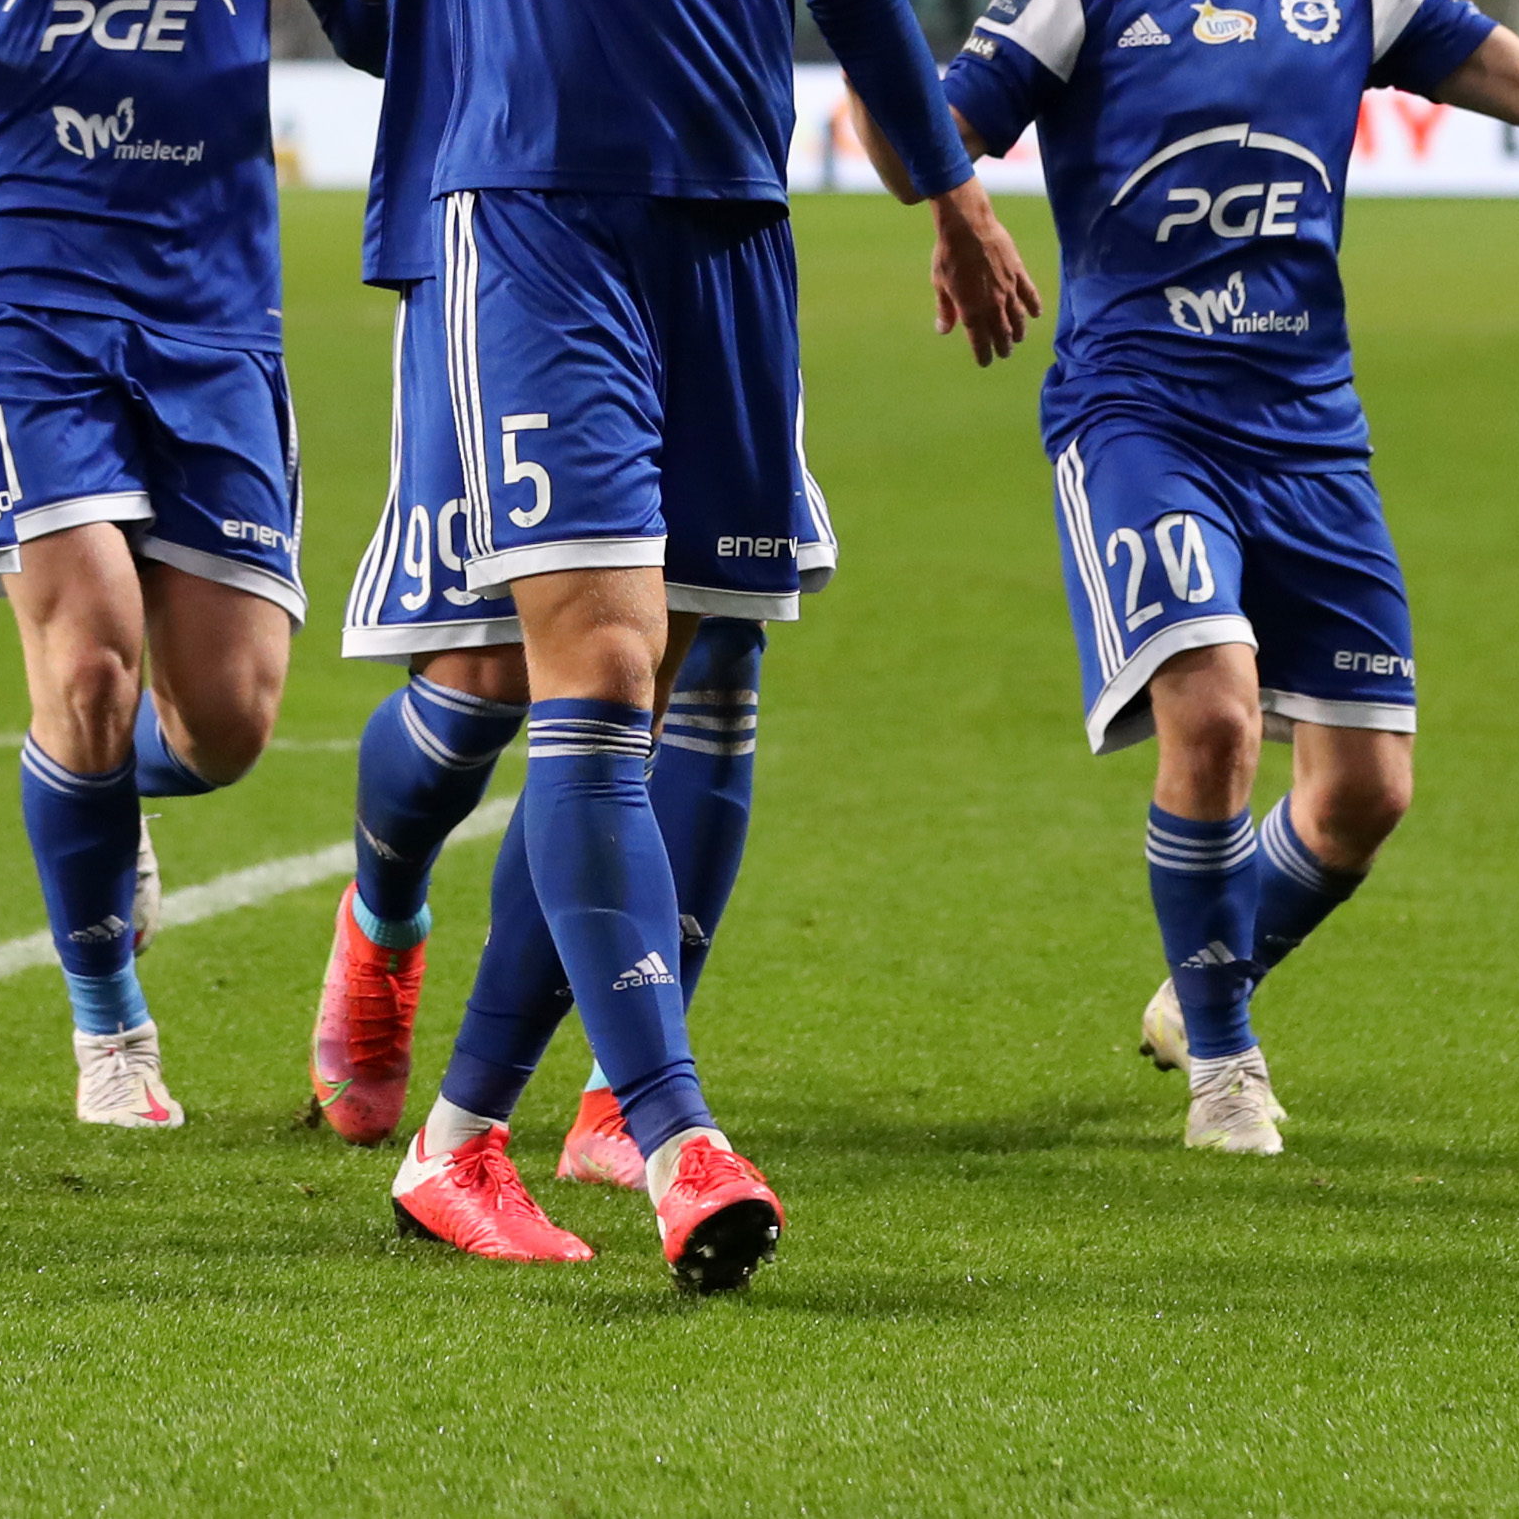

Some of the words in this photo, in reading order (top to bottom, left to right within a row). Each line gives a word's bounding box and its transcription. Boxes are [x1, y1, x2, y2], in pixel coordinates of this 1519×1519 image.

[1118, 32, 1172, 48] adidas
[1207, 18, 1242, 35] LOTTO
[114, 138, 205, 166] mielec.pl
[1156, 181, 1304, 243] PGE
[1232, 308, 1310, 336] mielec.pl
[502, 413, 552, 528] 5
[1105, 513, 1215, 632] 20
[613, 973, 675, 991] adidas
